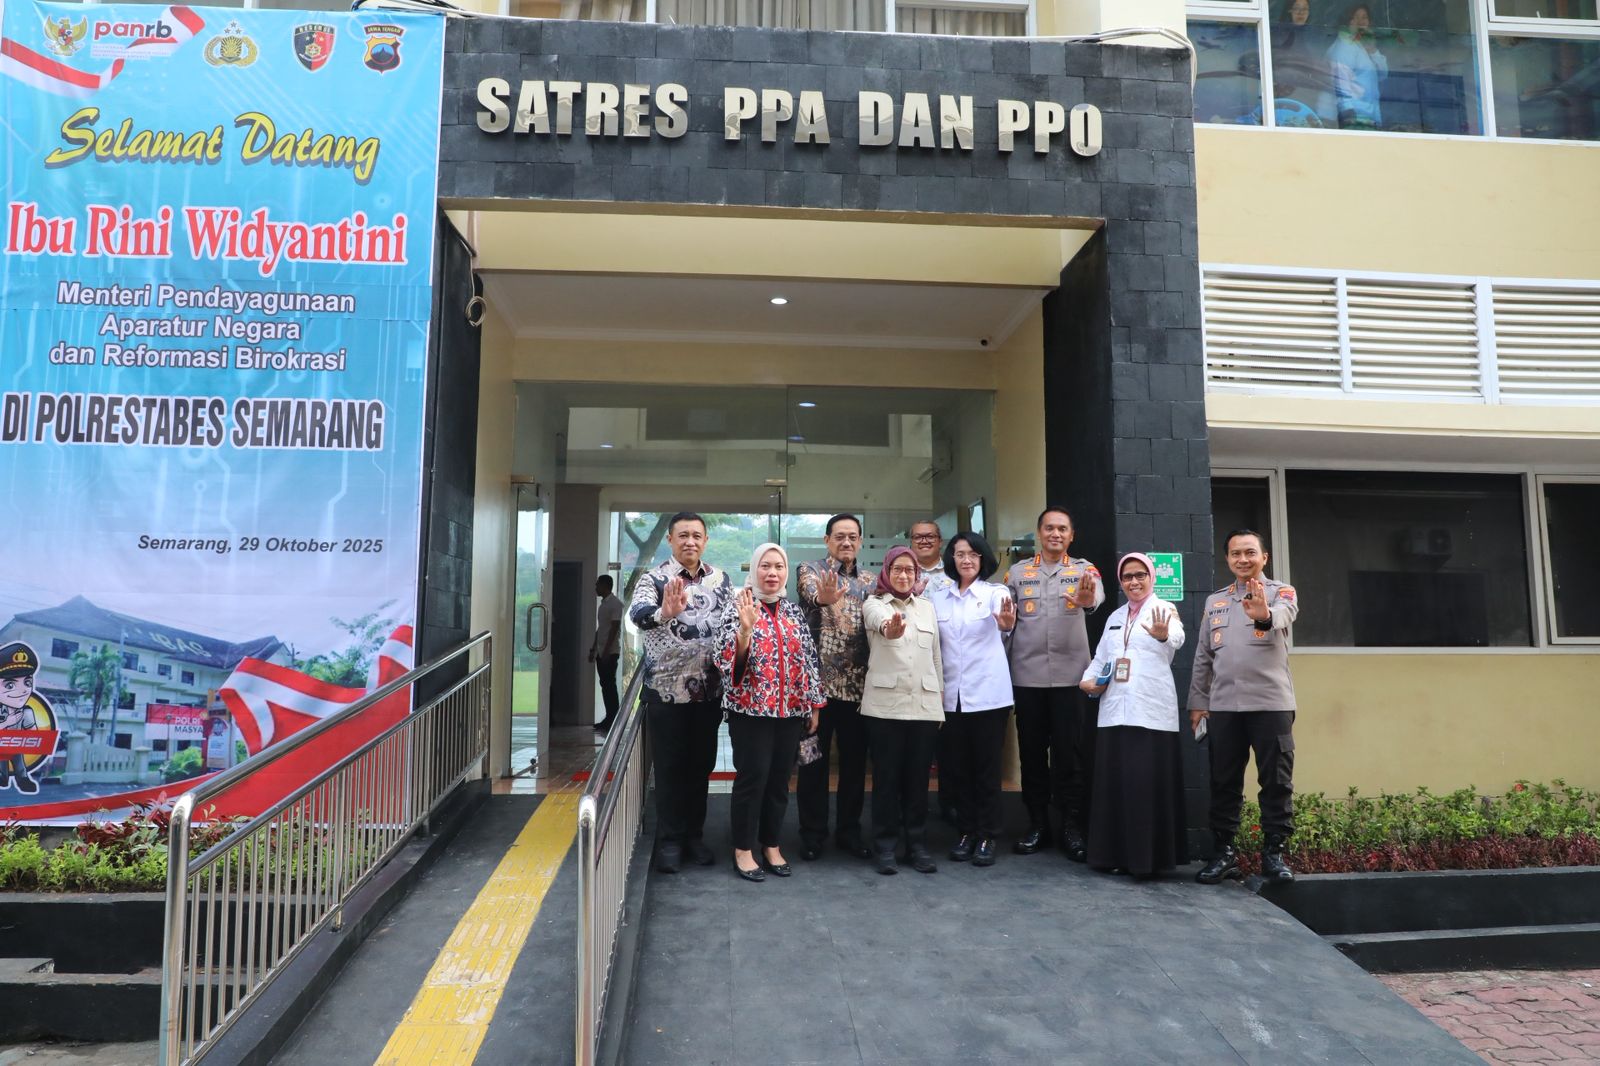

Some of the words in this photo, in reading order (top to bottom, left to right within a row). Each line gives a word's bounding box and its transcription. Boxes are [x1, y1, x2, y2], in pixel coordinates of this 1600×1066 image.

[94, 20, 172, 40] panrb
[476, 77, 688, 139] SATRES
[724, 87, 830, 145] PPA
[858, 91, 974, 151] DAN
[998, 98, 1103, 157] PPO
[45, 107, 223, 168] Selamat
[235, 111, 380, 183] Datang
[7, 203, 76, 254] Ibu
[86, 204, 171, 257] Rini
[185, 208, 407, 276] Widyantini
[57, 281, 151, 307] Menteri
[157, 285, 355, 316] Pendayagunaan
[99, 313, 207, 341] Aparatur
[213, 316, 301, 345] Negara
[49, 341, 96, 366] dan
[103, 343, 228, 369] Reformasi
[235, 346, 347, 372] Birokrasi
[3, 394, 29, 442] DI
[35, 394, 225, 448] POLRESTABES
[232, 399, 384, 450] SEMARANG
[137, 534, 232, 554] Semarang,
[239, 537, 260, 552] 29
[265, 537, 337, 553] Oktober
[342, 538, 383, 554] 2025
[0, 736, 42, 748] ESISI
